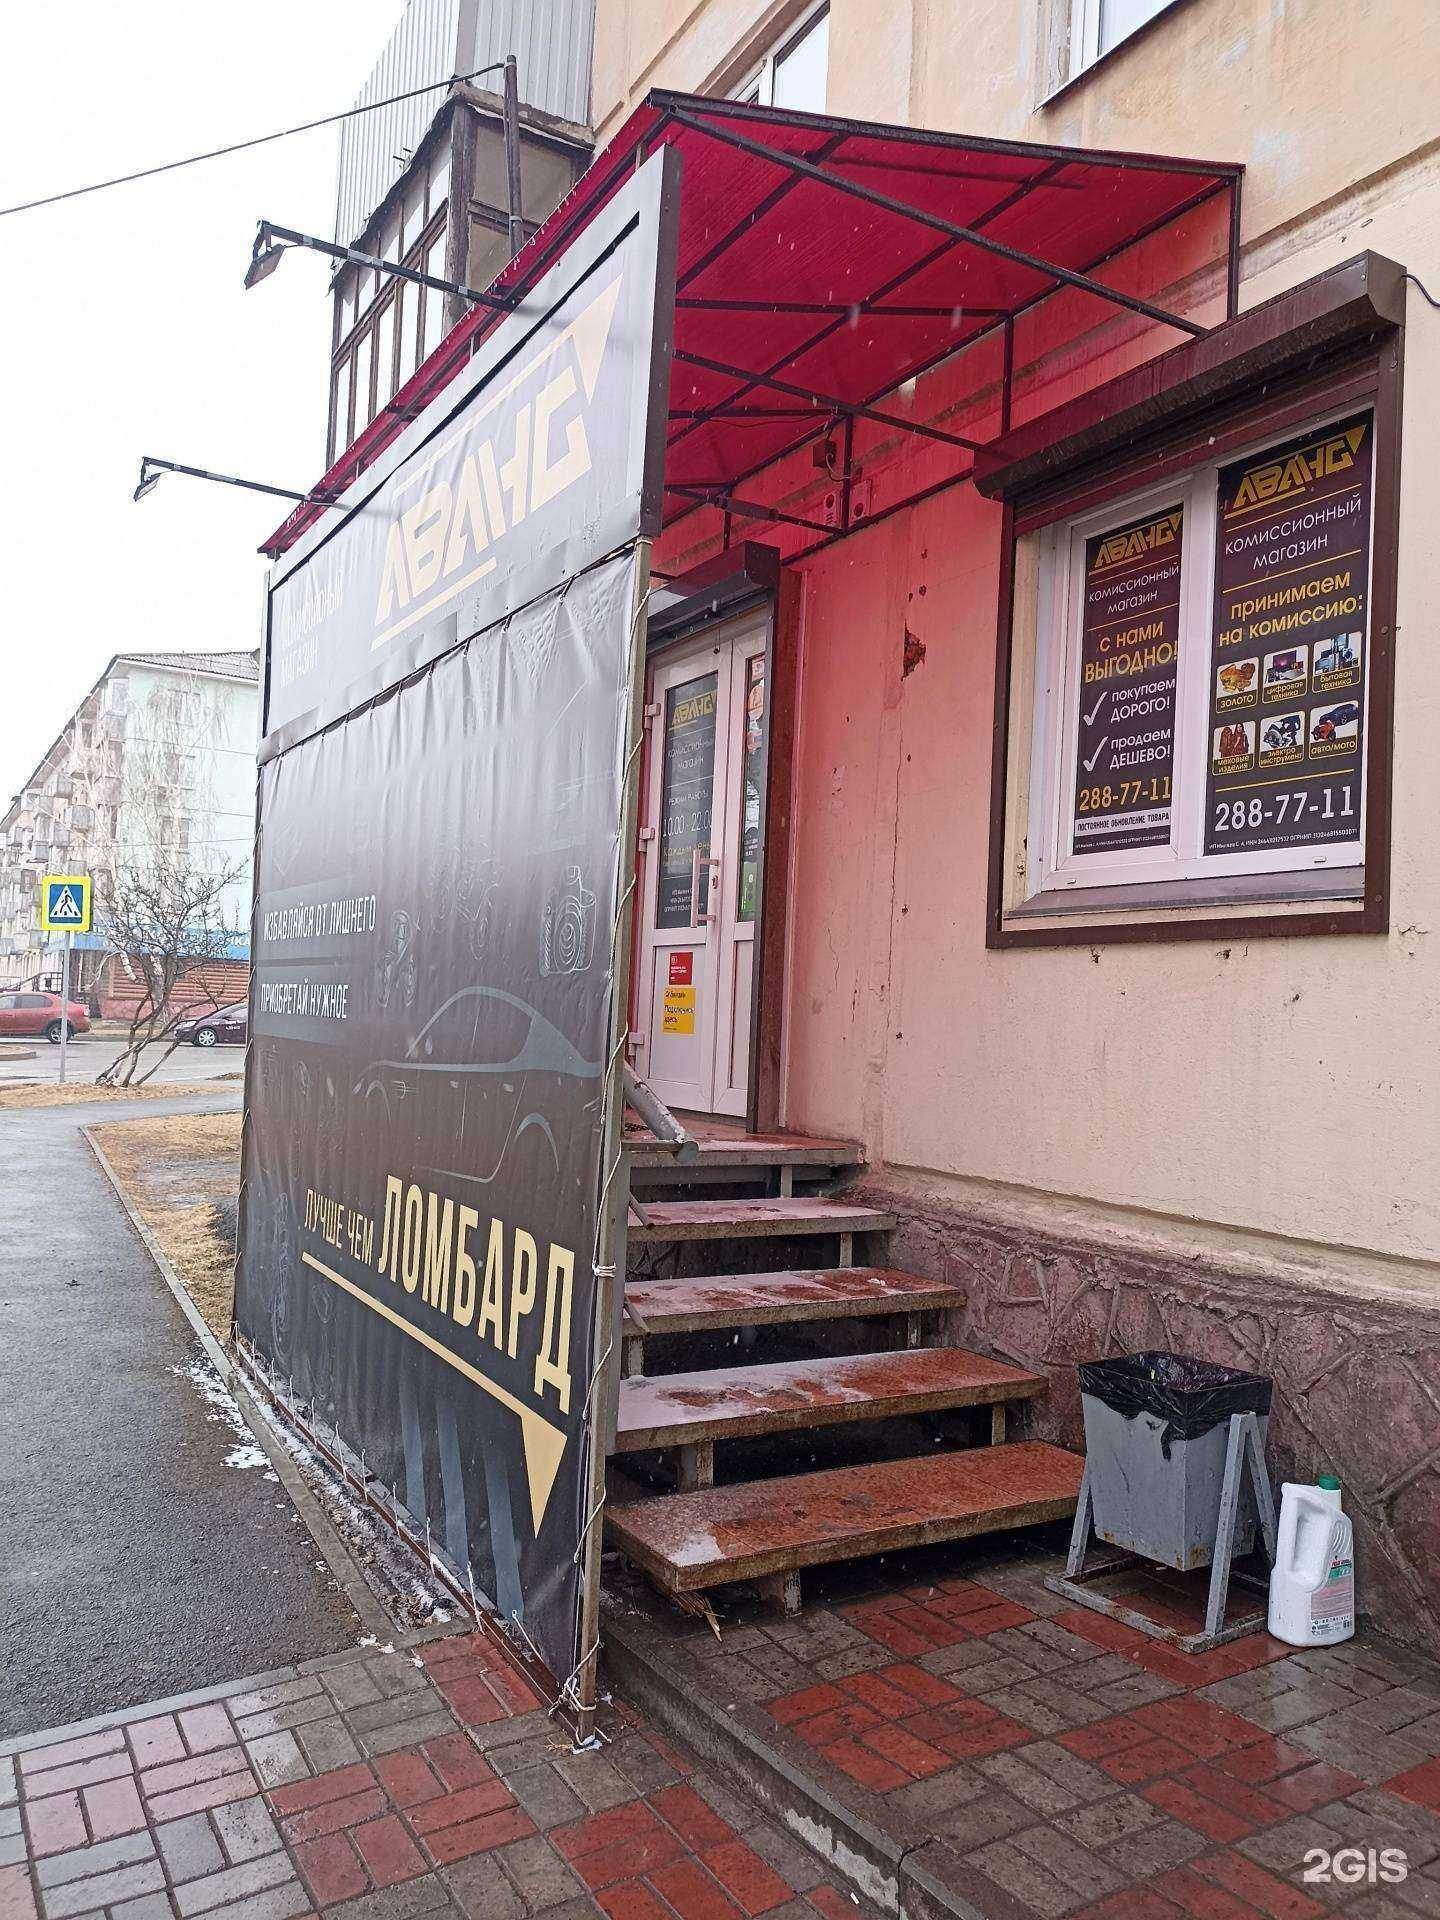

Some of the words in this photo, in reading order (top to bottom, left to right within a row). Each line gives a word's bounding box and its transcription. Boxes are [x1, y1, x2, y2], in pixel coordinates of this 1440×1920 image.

[1233, 439, 1354, 509] АВАНС
[374, 365, 593, 627] АВАНС
[1094, 522, 1177, 568] АВАНС
[1225, 493, 1362, 555] комиссионный
[1253, 533, 1328, 570] магазин
[1107, 590, 1158, 615] магазин
[1230, 571, 1351, 622] принимаем
[1117, 621, 1163, 647] нами
[1219, 628, 1243, 647] на
[1249, 594, 1363, 640] комиссию:
[1084, 640, 1178, 683] ВЫГОДНО!
[1111, 678, 1176, 702] покупаем
[1111, 696, 1170, 723] ДОРОГО!
[1220, 695, 1254, 709] золото
[1109, 745, 1170, 770] ДЕШЕВО!
[1111, 728, 1171, 750] продаем
[1079, 776, 1171, 811] 288-77-11
[1214, 785, 1354, 832] 288-77-11
[263, 902, 314, 942] ИЗБАВЛЯЙСЯ
[314, 901, 328, 937] ОТ
[328, 895, 376, 936] ЛИШНЕГО
[260, 978, 309, 1017] ПРИОБРЕТАЙ
[310, 983, 348, 1020] НУЖНОЕ
[304, 1188, 344, 1249] ЛУЧШЕ
[347, 1208, 374, 1266] ЧЕМ
[378, 1174, 575, 1416] ЛОМБАРД
